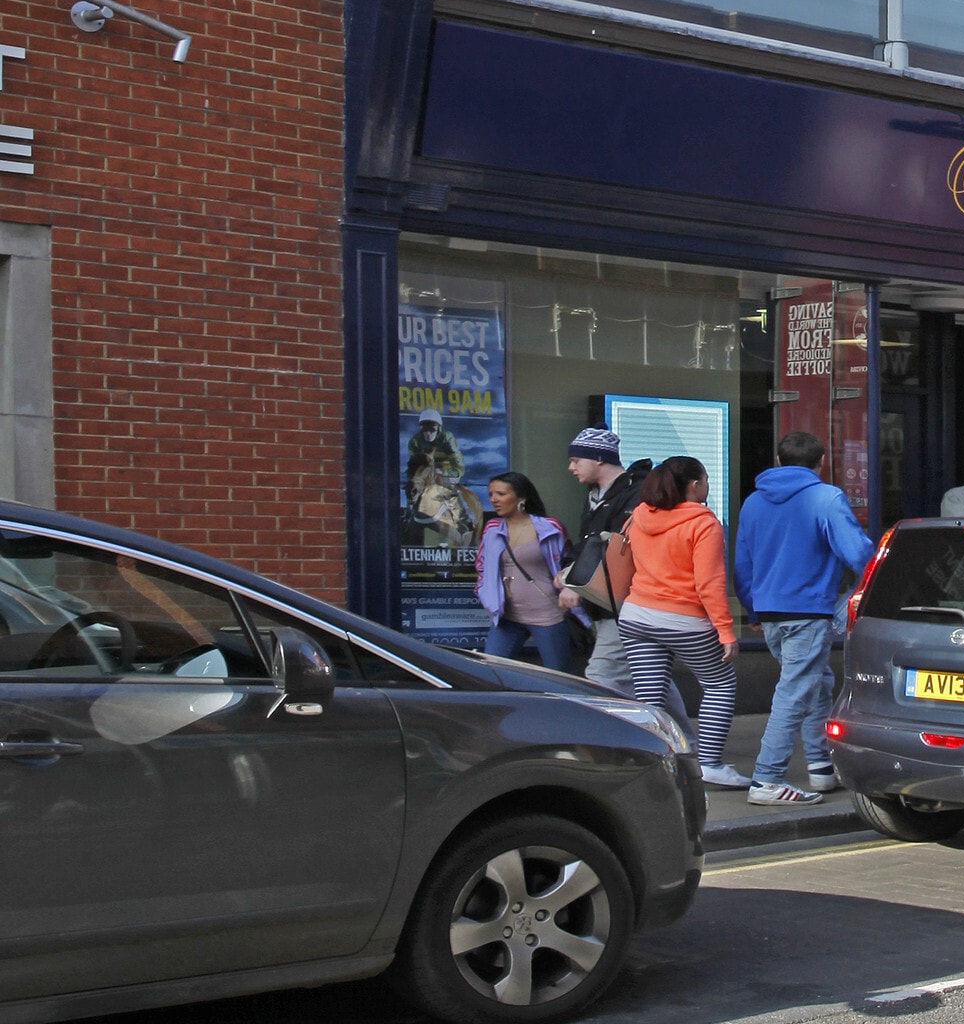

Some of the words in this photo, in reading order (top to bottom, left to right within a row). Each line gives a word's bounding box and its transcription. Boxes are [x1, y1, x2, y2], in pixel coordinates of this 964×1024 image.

[432, 318, 489, 349] BEST
[398, 346, 490, 386] RICES
[448, 389, 492, 414] 9AM
[418, 597, 452, 605] GAMBLE
